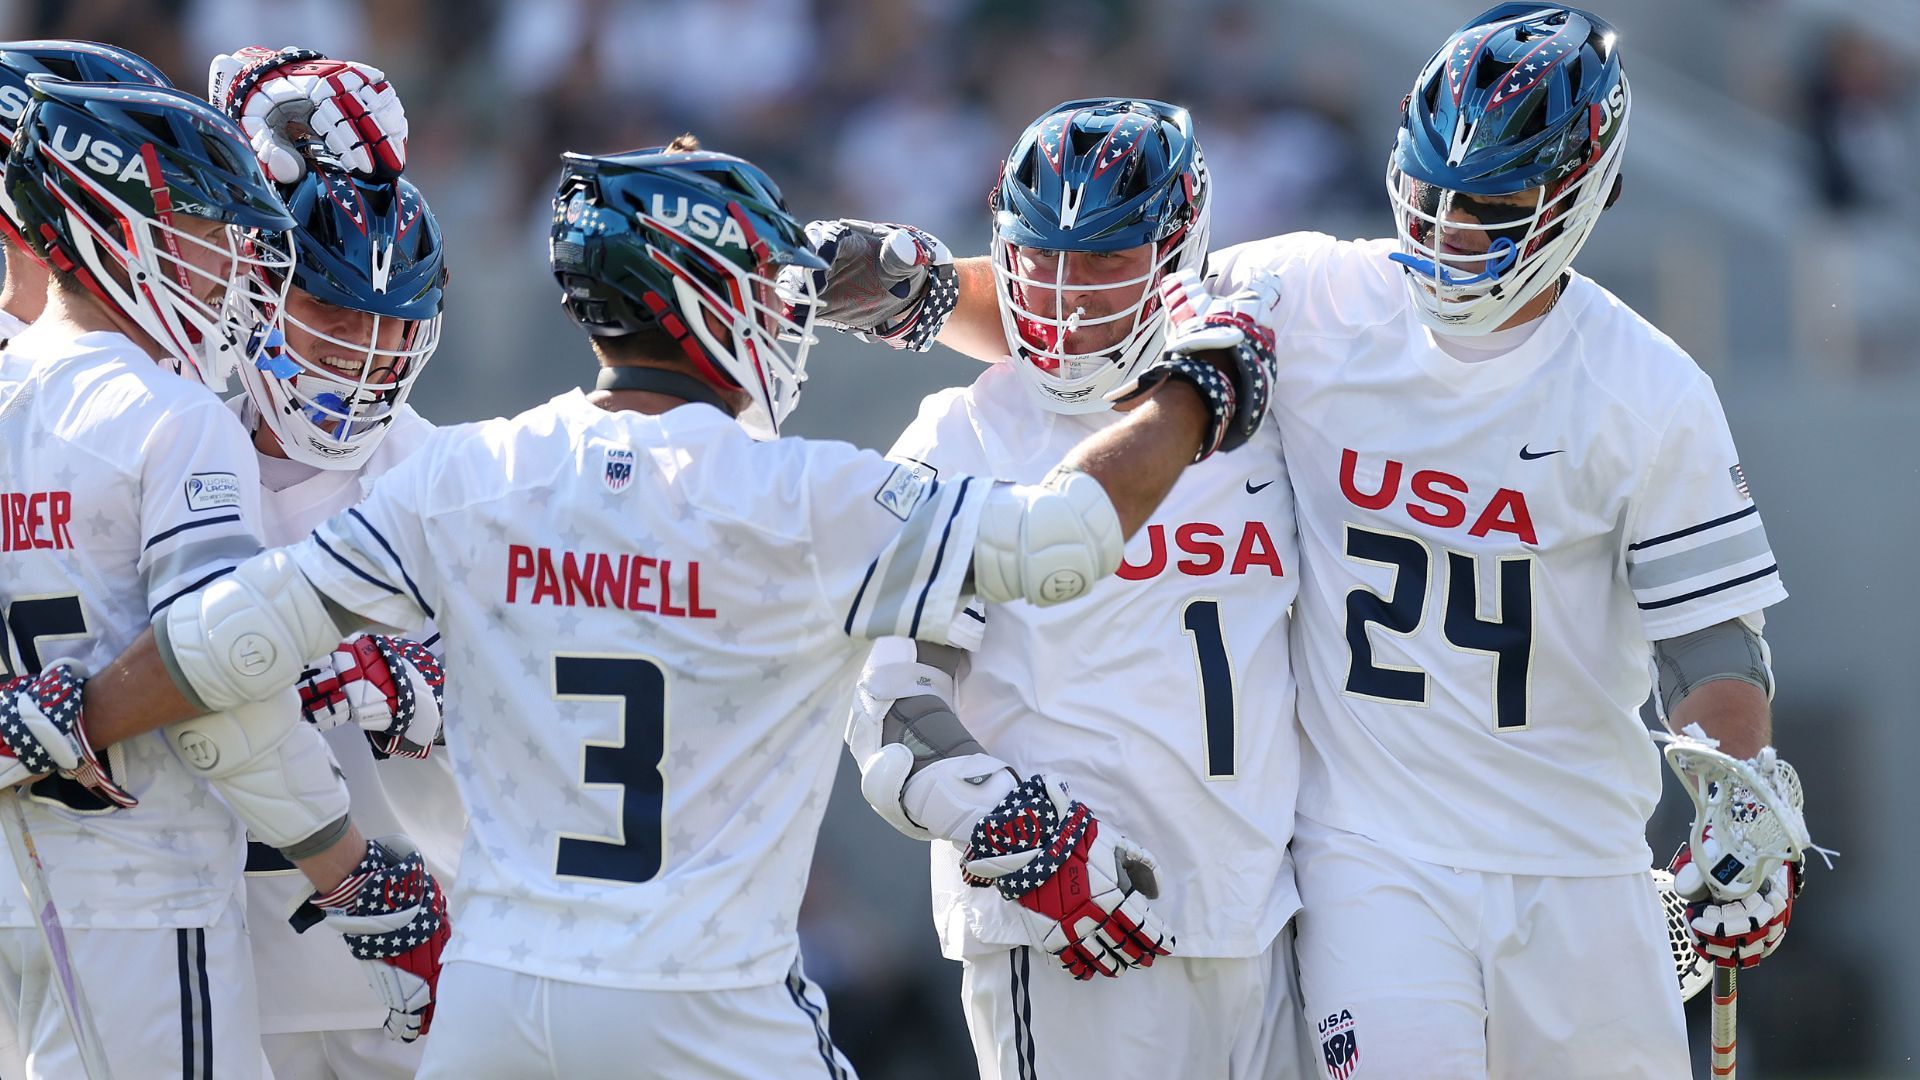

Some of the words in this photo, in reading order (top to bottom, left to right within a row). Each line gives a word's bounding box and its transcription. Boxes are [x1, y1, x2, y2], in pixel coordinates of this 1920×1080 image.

[52, 125, 152, 188] USA
[652, 194, 748, 250] USA
[608, 450, 633, 458] USA
[0, 491, 75, 552] IBER
[1339, 447, 1539, 546] USA
[1114, 521, 1284, 580] USA
[506, 544, 717, 619] PANNELL
[1341, 521, 1536, 734] 24
[1179, 595, 1240, 782] 1
[551, 650, 670, 886] 3
[1069, 866, 1080, 895] EVO
[1716, 860, 1738, 880] EVO
[1318, 1009, 1353, 1034] USA
